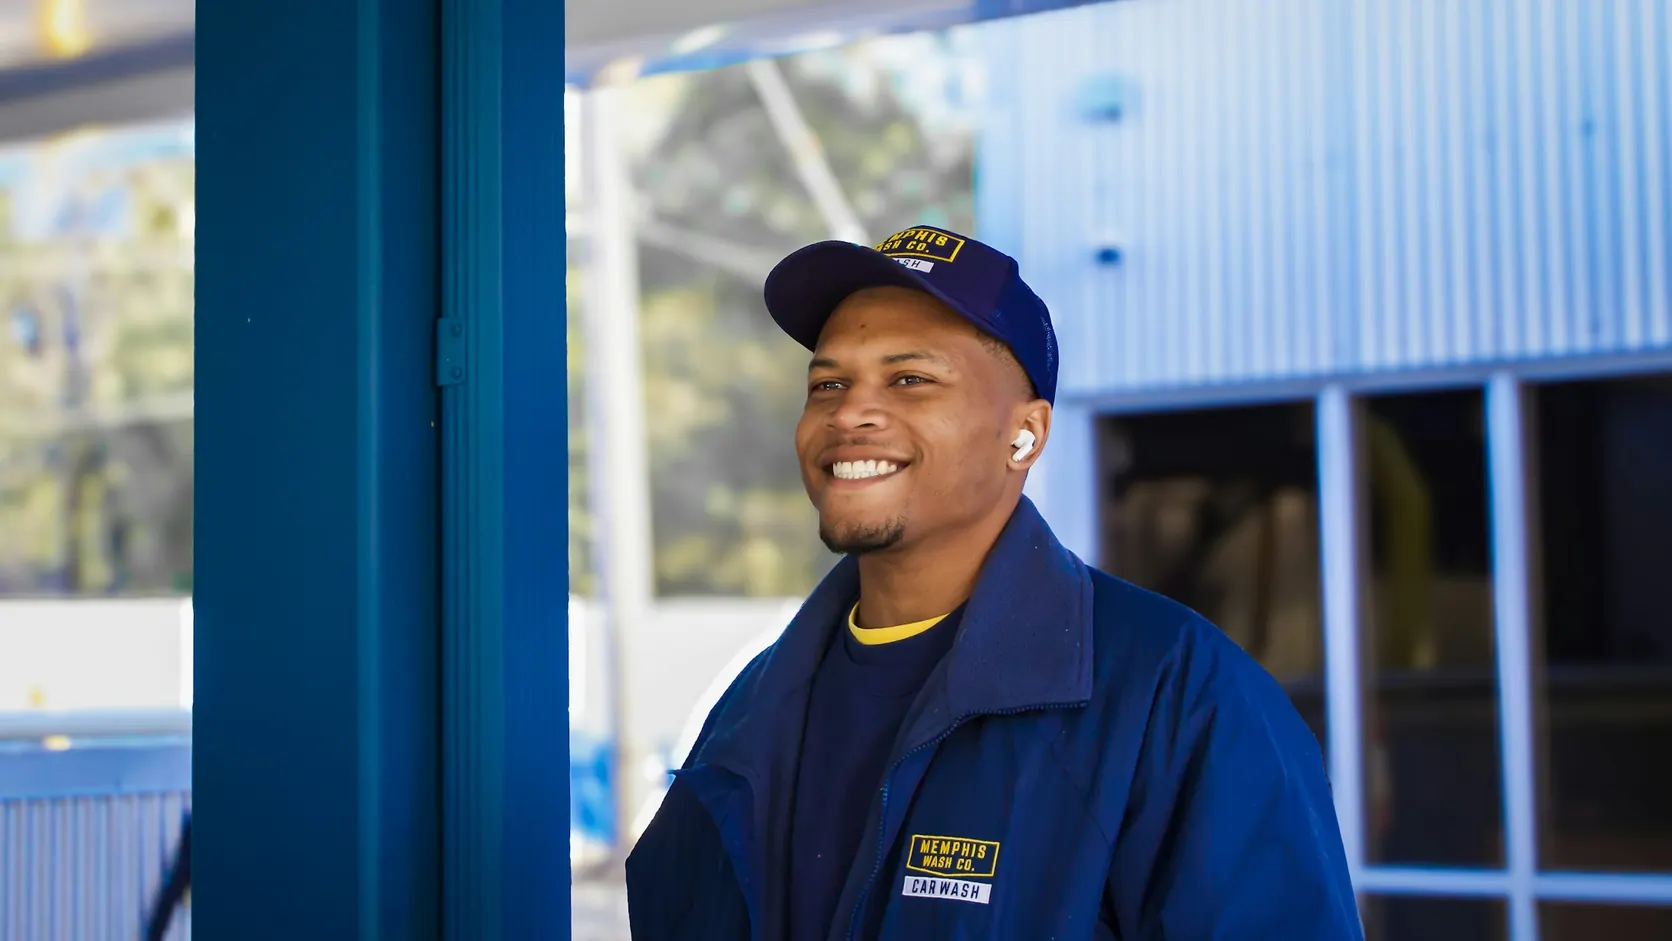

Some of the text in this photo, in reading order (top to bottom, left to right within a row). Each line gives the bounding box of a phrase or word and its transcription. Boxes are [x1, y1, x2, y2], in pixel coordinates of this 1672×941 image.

[906, 240, 930, 253] CO.
[920, 840, 987, 859] MEMPHIS
[923, 855, 975, 872] WASH CO.
[911, 879, 980, 899] CAR WASH
